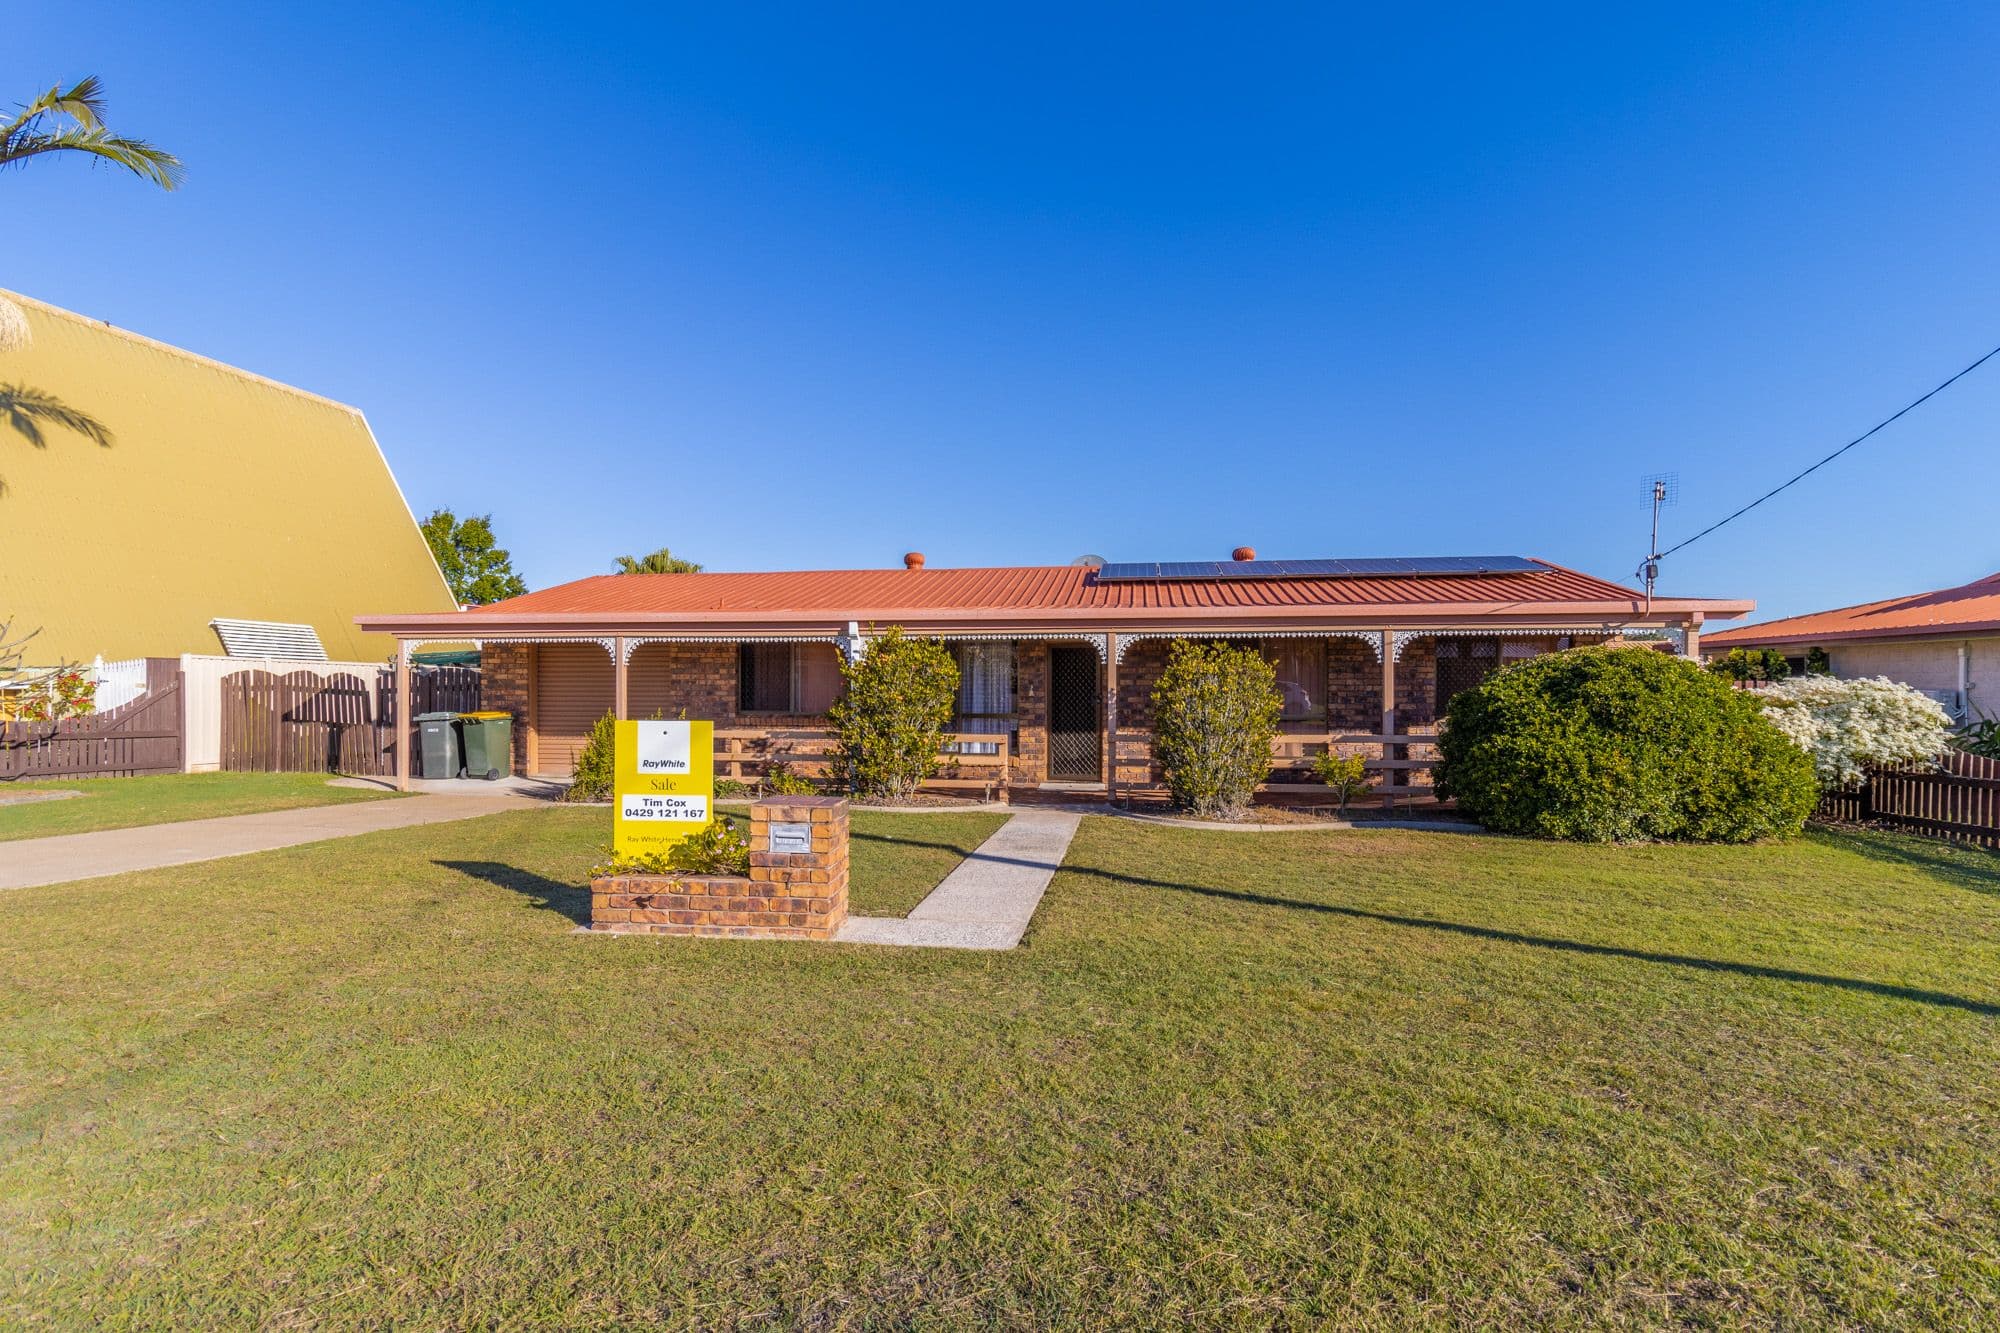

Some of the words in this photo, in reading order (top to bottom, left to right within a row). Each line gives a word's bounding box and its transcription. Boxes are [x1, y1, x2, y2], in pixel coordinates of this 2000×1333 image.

[650, 778, 677, 791] Sale
[642, 798, 663, 807] Tim
[666, 798, 687, 807] Cox
[625, 808, 654, 817] 0429
[657, 809, 679, 818] 121
[683, 809, 705, 818] 167
[627, 835, 639, 843] Ray
